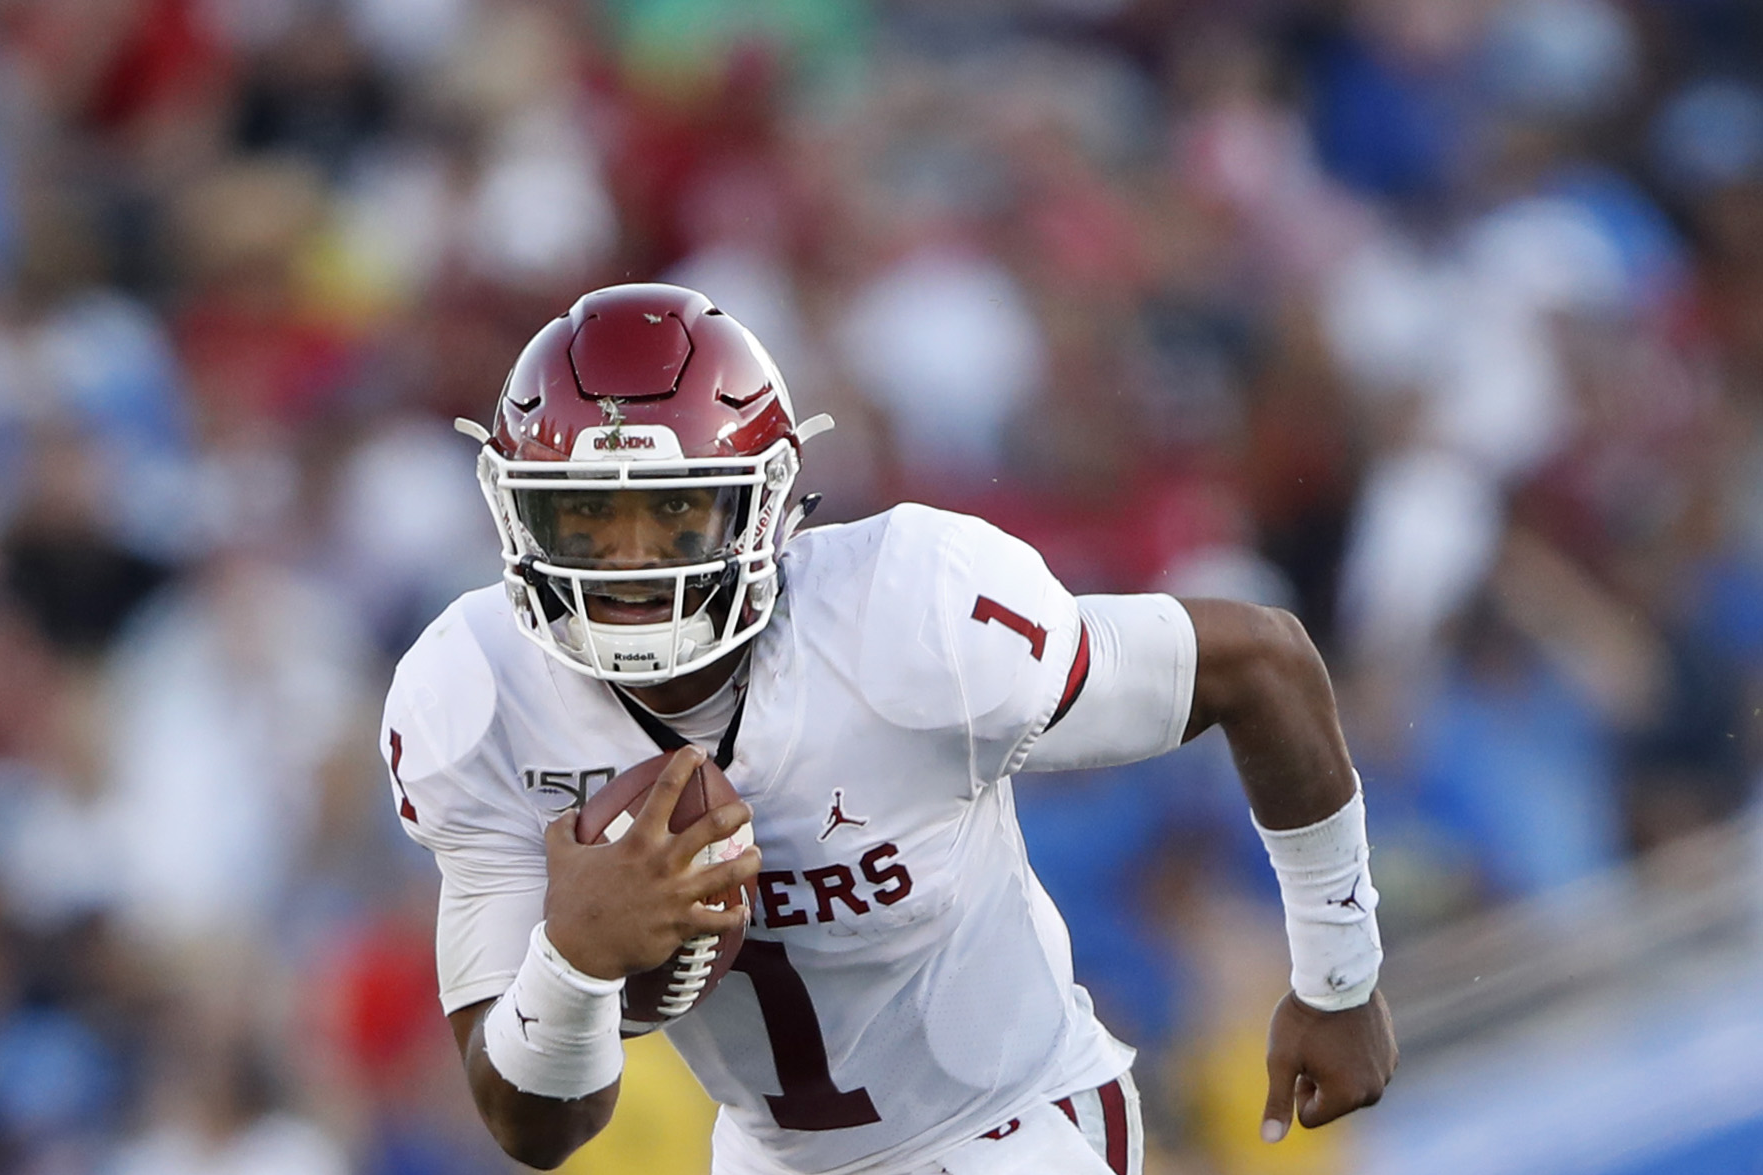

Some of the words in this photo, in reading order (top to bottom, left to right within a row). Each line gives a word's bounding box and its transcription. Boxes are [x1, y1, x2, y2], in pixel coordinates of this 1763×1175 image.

[594, 436, 656, 450] OKAHOMA
[614, 652, 655, 661] Riddell
[971, 595, 1048, 662] 1
[750, 842, 913, 928] ERS
[732, 939, 882, 1131] 1
